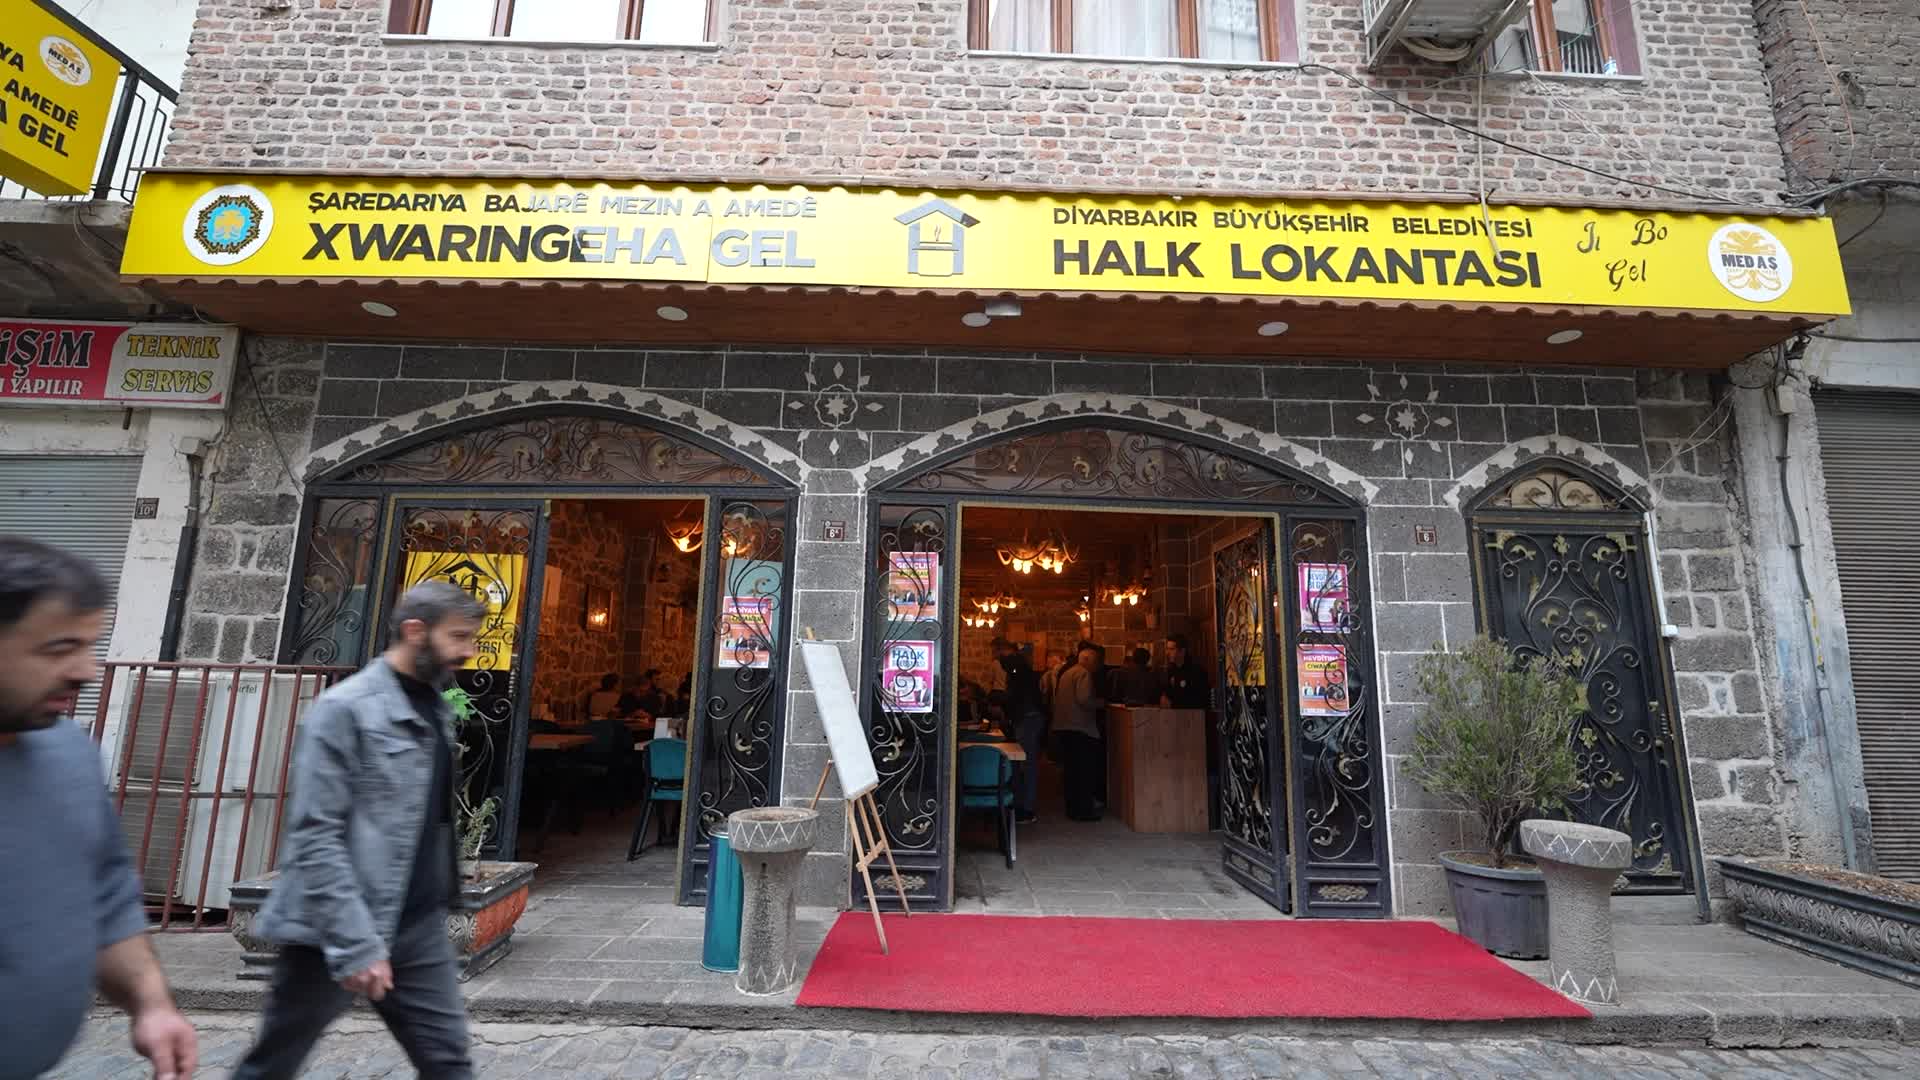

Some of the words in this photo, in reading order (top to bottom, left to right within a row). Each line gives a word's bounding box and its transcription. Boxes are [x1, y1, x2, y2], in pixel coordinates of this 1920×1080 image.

[4, 78, 79, 132] AMEDÊ
[18, 112, 69, 158] GEL
[308, 192, 467, 214] ŞAREDARIYA
[484, 193, 588, 214] BAJARÊ
[600, 196, 683, 216] MEZIN
[692, 200, 713, 217] A
[723, 197, 817, 218] AMEDÊ
[1053, 205, 1198, 228] DİYARBAKIR
[1214, 209, 1370, 234] BÜYÜKŞEHİR
[1392, 216, 1533, 238] BELEDİYESİ
[302, 223, 687, 266] XWARINGEHA
[711, 229, 816, 268] GEL
[1631, 218, 1667, 246] Bo
[1053, 239, 1204, 278] HALK
[1230, 243, 1542, 288] LOKANTASI
[1605, 258, 1646, 292] Gel
[891, 649, 925, 660] HALK
